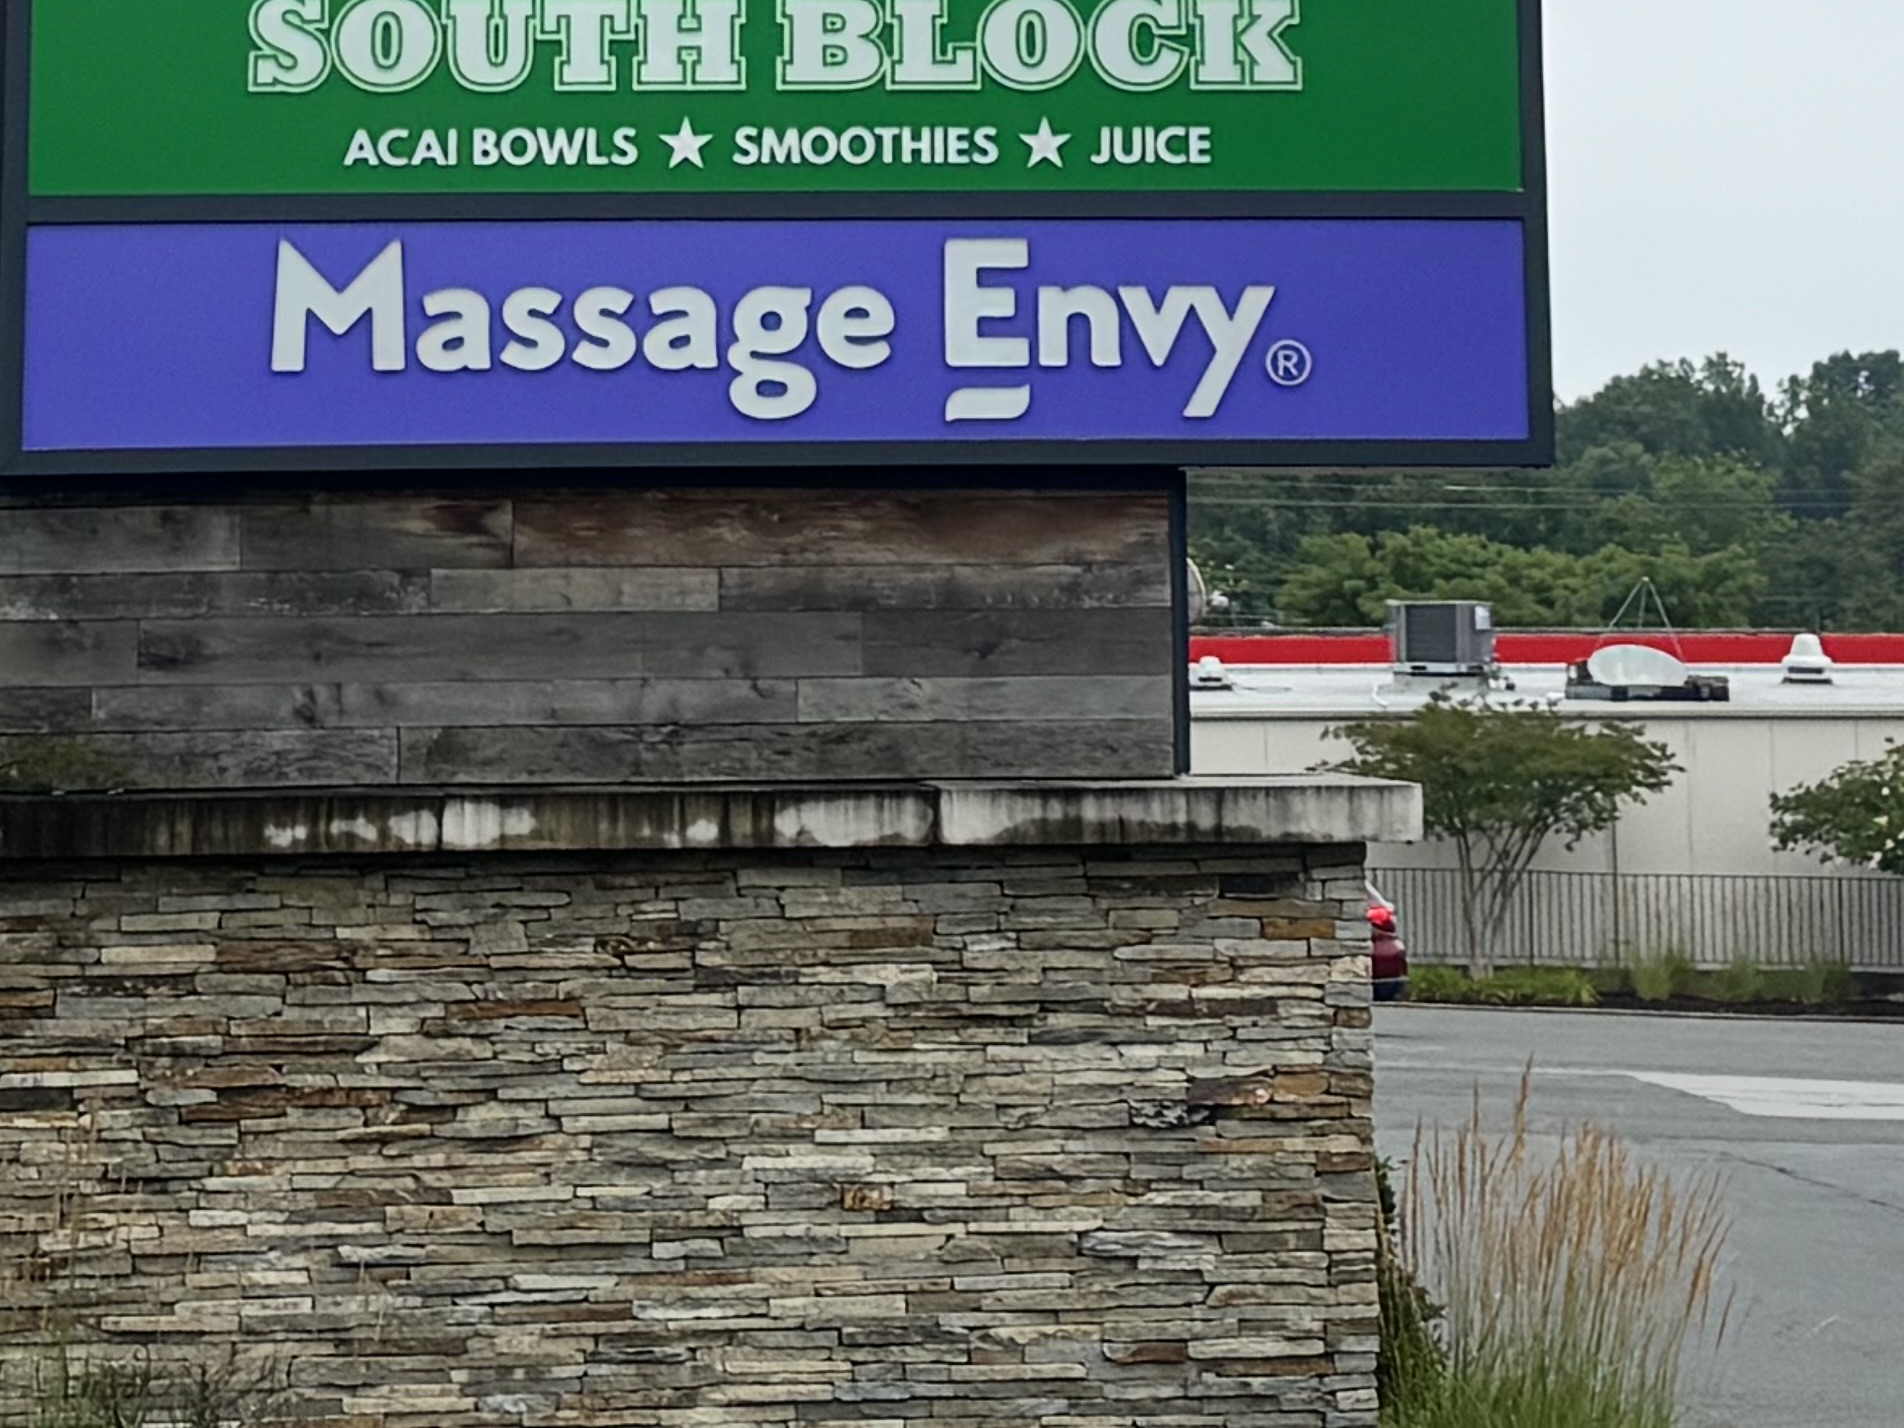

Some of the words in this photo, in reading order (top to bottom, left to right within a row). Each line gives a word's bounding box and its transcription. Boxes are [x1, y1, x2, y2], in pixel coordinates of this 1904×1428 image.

[343, 127, 458, 167] ACAI
[472, 127, 639, 166] BOWLS
[732, 126, 999, 166] SMOOTHIES
[1090, 126, 1212, 165] JUICE
[270, 239, 896, 420] Massage
